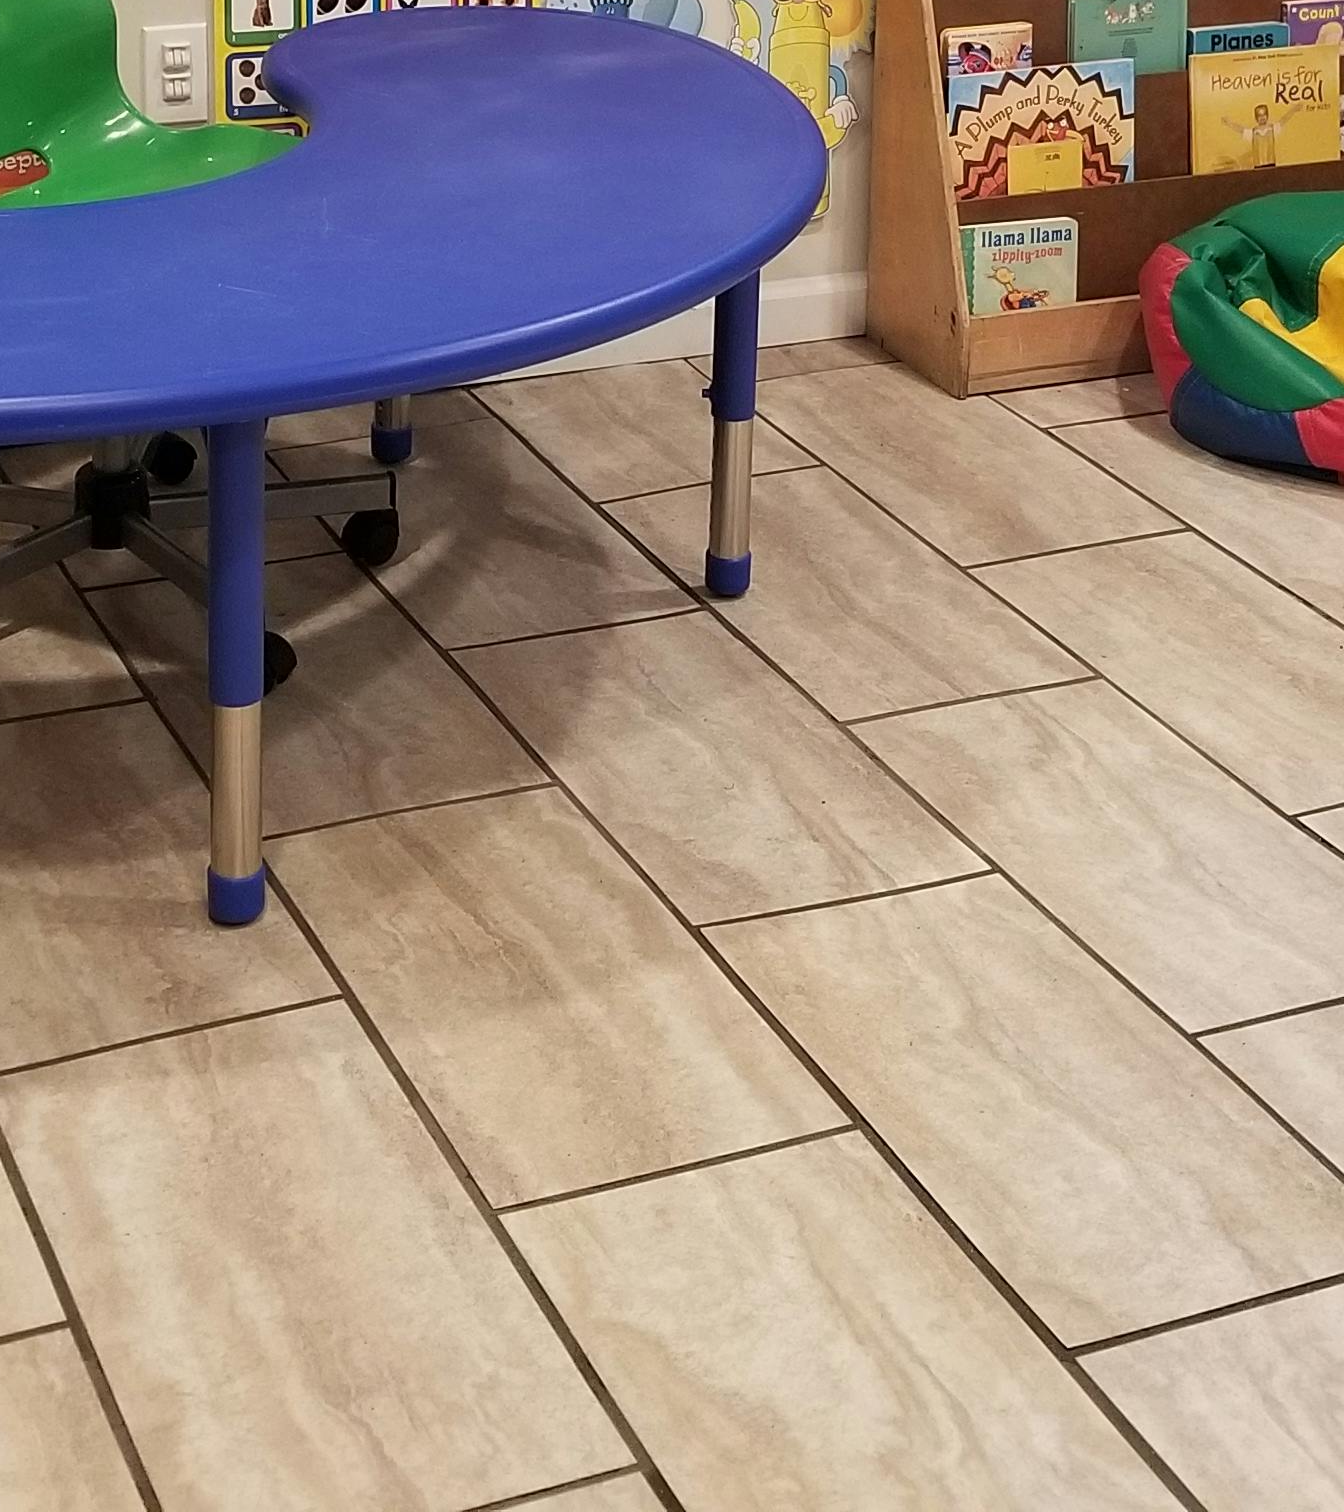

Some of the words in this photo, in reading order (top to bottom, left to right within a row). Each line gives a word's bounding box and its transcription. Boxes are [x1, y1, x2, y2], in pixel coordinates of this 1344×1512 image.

[1297, 4, 1340, 21] Count
[1210, 31, 1275, 53] Planes
[1210, 69, 1273, 92] Heaven
[1275, 67, 1293, 85] is
[1296, 65, 1323, 85] for
[1274, 79, 1325, 105] Real
[965, 104, 1014, 142] Plump
[1015, 84, 1042, 111] and
[1044, 83, 1085, 117] Perky
[1086, 96, 1125, 147] Turkey
[981, 229, 1025, 249] llama
[1029, 226, 1073, 246] llama
